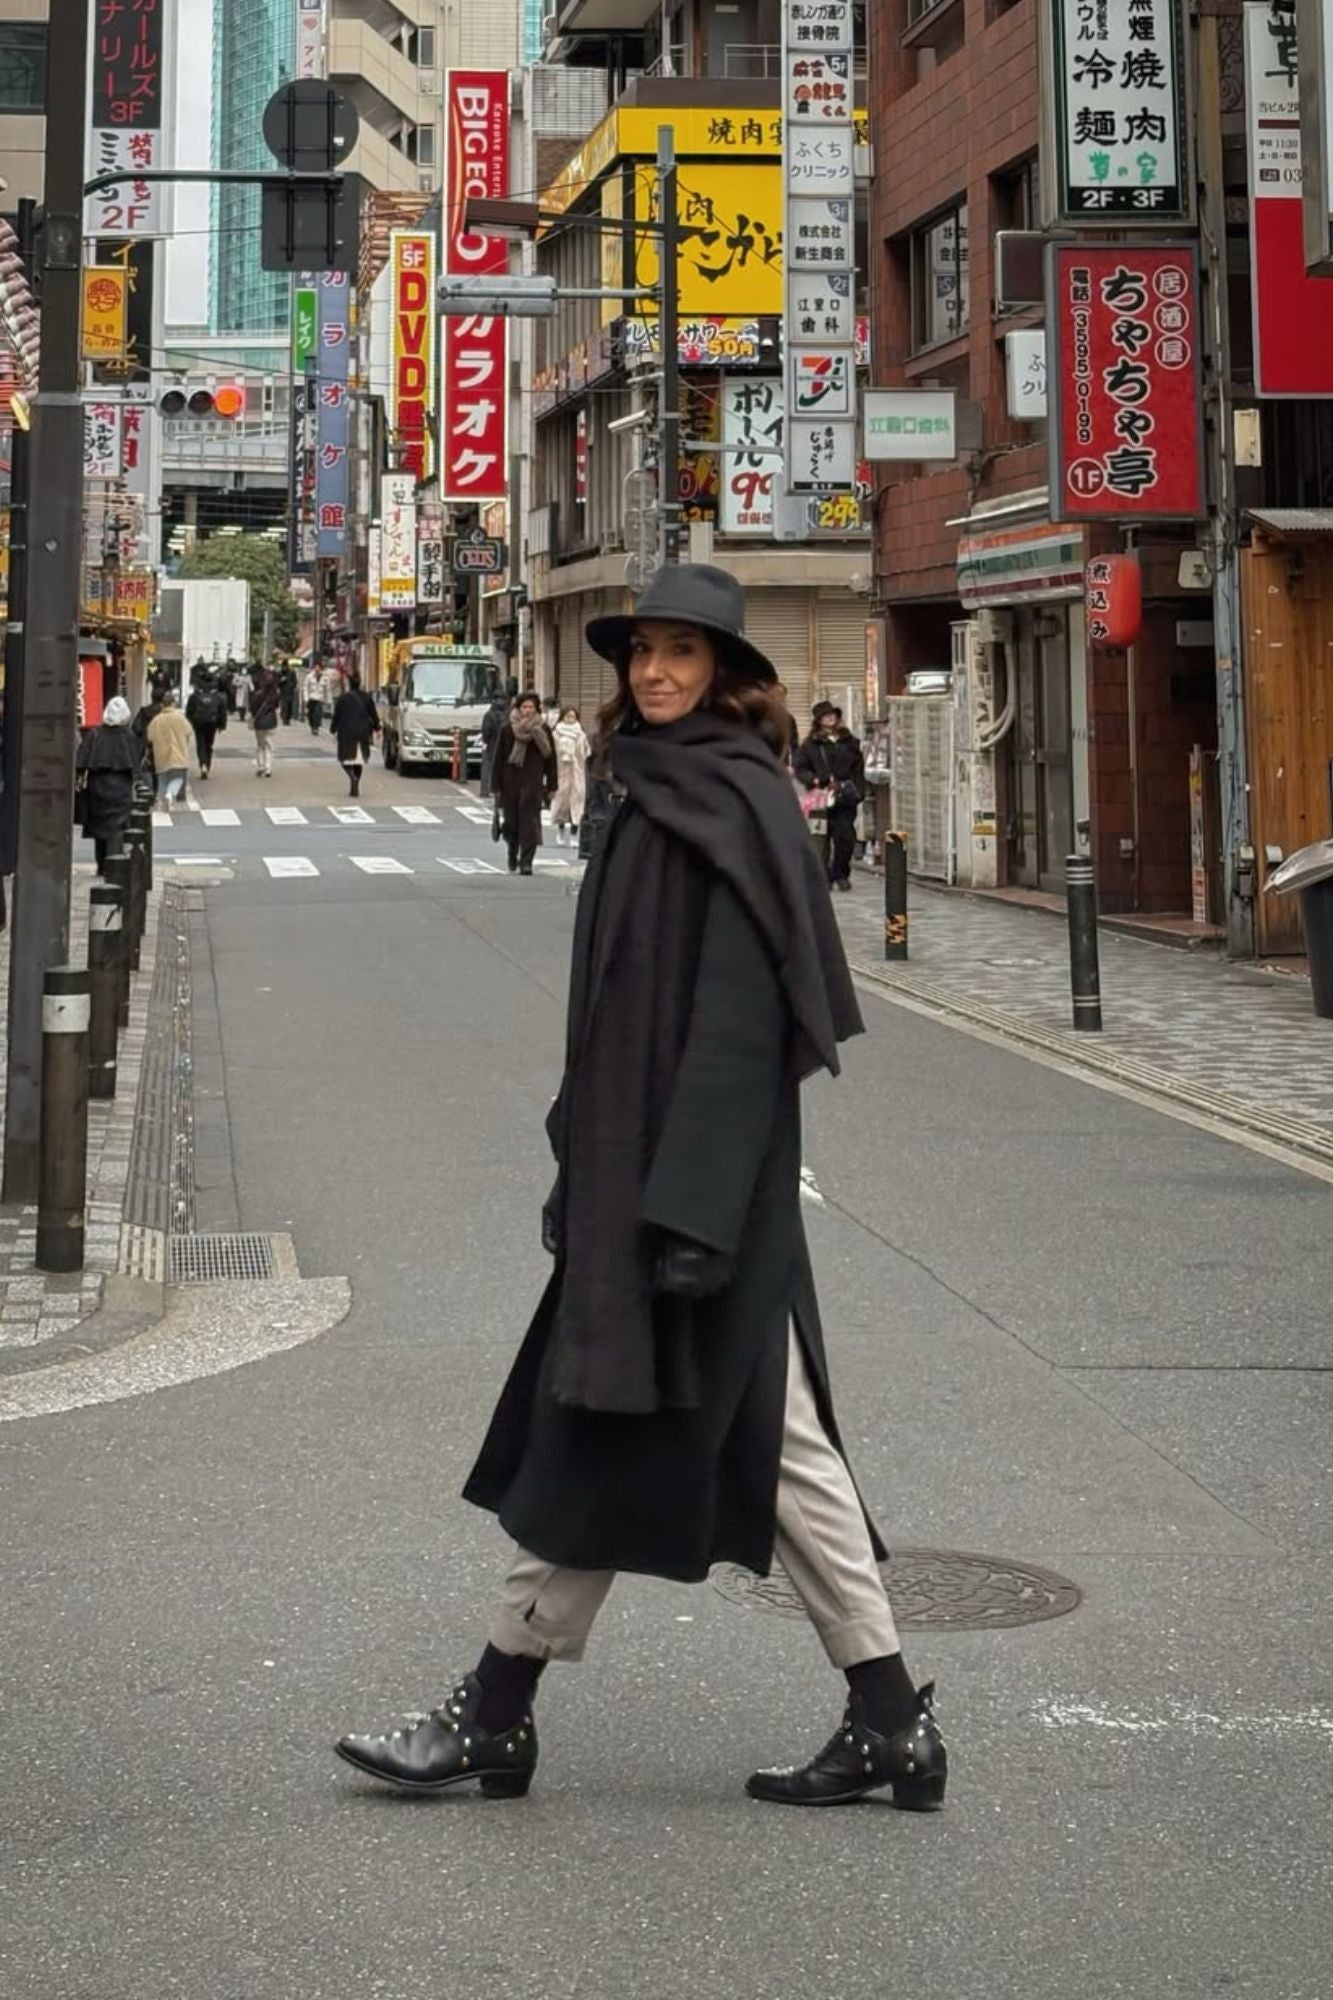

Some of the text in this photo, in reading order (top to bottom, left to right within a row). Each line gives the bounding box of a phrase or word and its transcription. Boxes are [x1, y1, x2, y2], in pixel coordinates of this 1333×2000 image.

[110, 101, 144, 122] 3F
[796, 141, 842, 159] ふくち
[790, 164, 850, 178] クリニック
[101, 205, 150, 230] 2F
[456, 161, 488, 262] ECO
[799, 224, 842, 239] 株式会社
[402, 250, 425, 267] 5F
[453, 313, 498, 487] カラオケ
